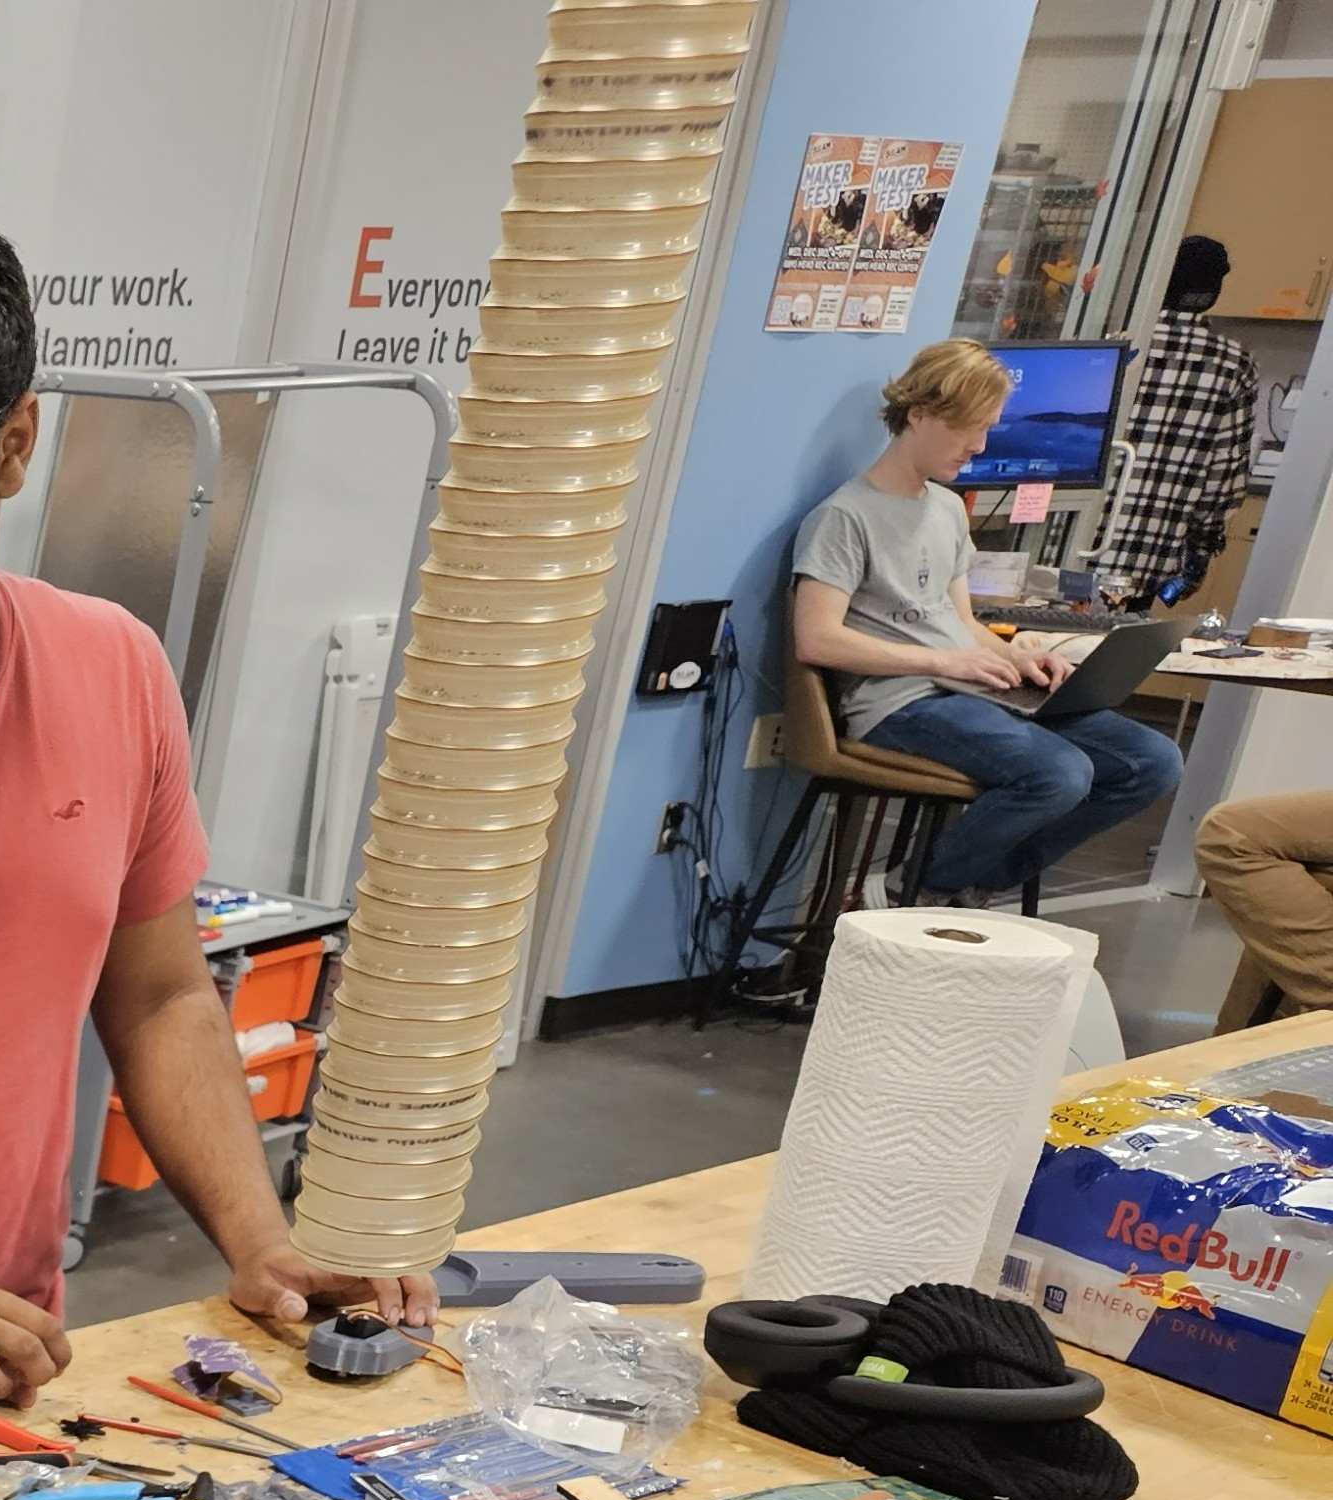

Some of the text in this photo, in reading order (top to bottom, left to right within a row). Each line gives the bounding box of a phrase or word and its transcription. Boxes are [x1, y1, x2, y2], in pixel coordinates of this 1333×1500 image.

[803, 163, 852, 186] MAKER
[876, 167, 927, 191] MAKER
[805, 185, 842, 205] FEST
[878, 189, 914, 209] FEST
[32, 267, 193, 315] your work.
[37, 326, 179, 368] lamping.
[430, 328, 449, 364] it
[1060, 1105, 1105, 1124] PACK
[1106, 1199, 1291, 1292] Red Bull
[1083, 1286, 1239, 1352] ENERGY DRINK
